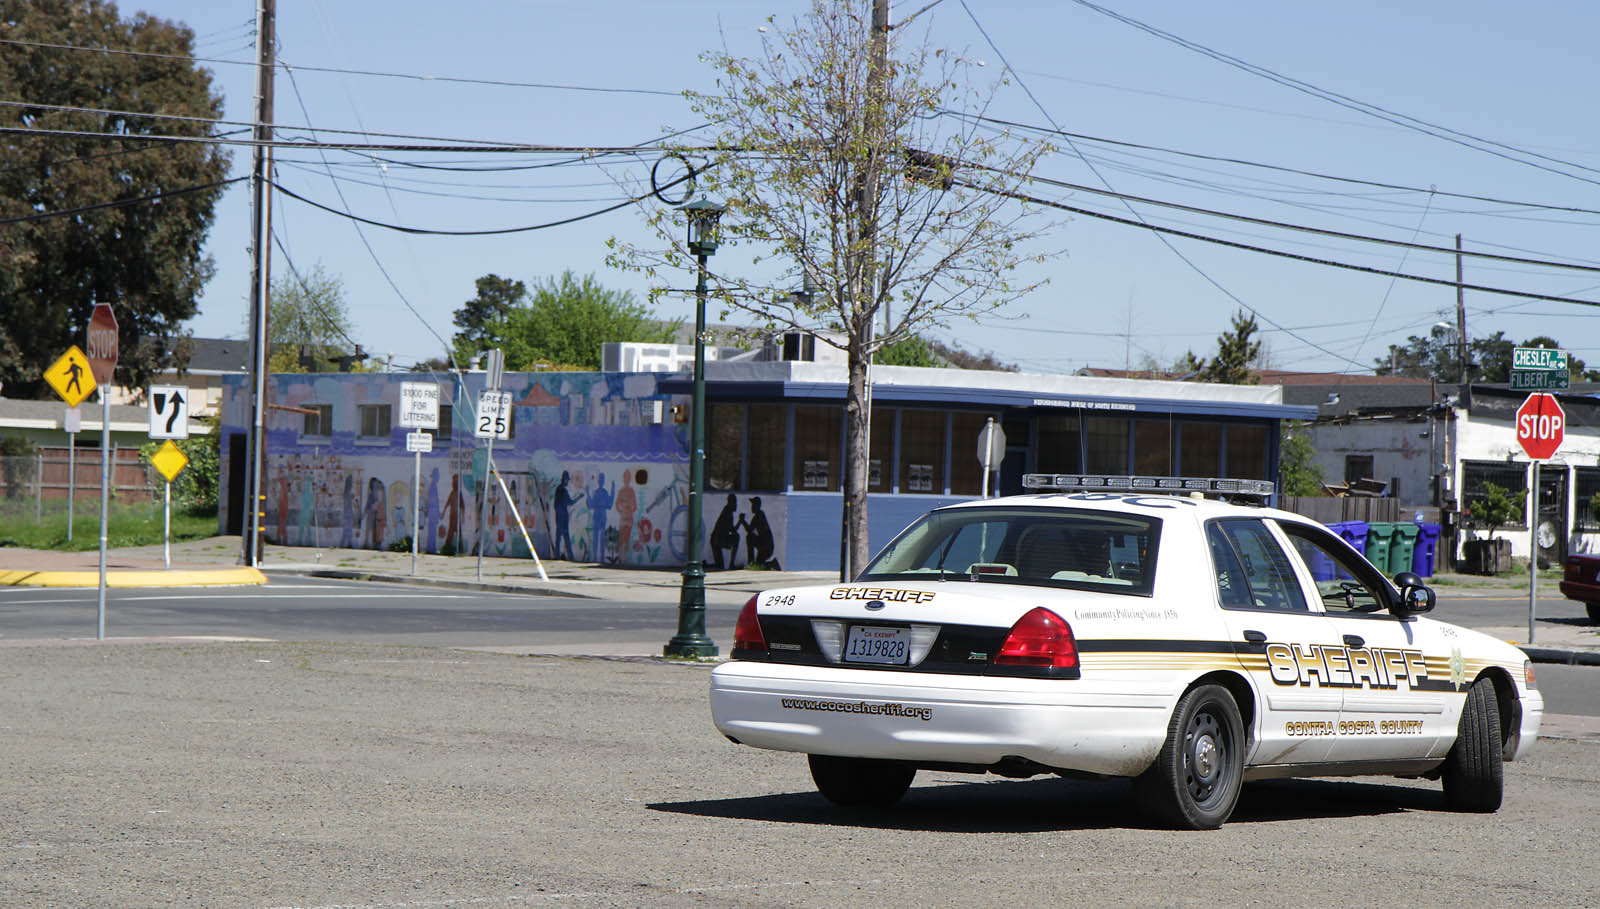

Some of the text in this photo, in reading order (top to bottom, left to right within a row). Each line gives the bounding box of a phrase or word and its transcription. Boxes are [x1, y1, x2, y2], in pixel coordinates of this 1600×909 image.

[89, 330, 115, 359] STOP
[1515, 350, 1551, 366] CHESLEY
[1511, 371, 1549, 388] FILBERT
[412, 401, 427, 410] FOR
[480, 394, 510, 404] SPEED
[403, 412, 436, 422] LITTERING
[479, 416, 506, 434] 25
[1520, 414, 1562, 440] STOP
[765, 594, 796, 607] 2948
[830, 587, 936, 604] SHERIFF
[850, 638, 904, 658] 1319828
[1266, 643, 1428, 690] SHERIFF
[782, 698, 932, 720] www.cocosheriff.org
[1285, 720, 1423, 736] CONTRA COSTA COUNTY
